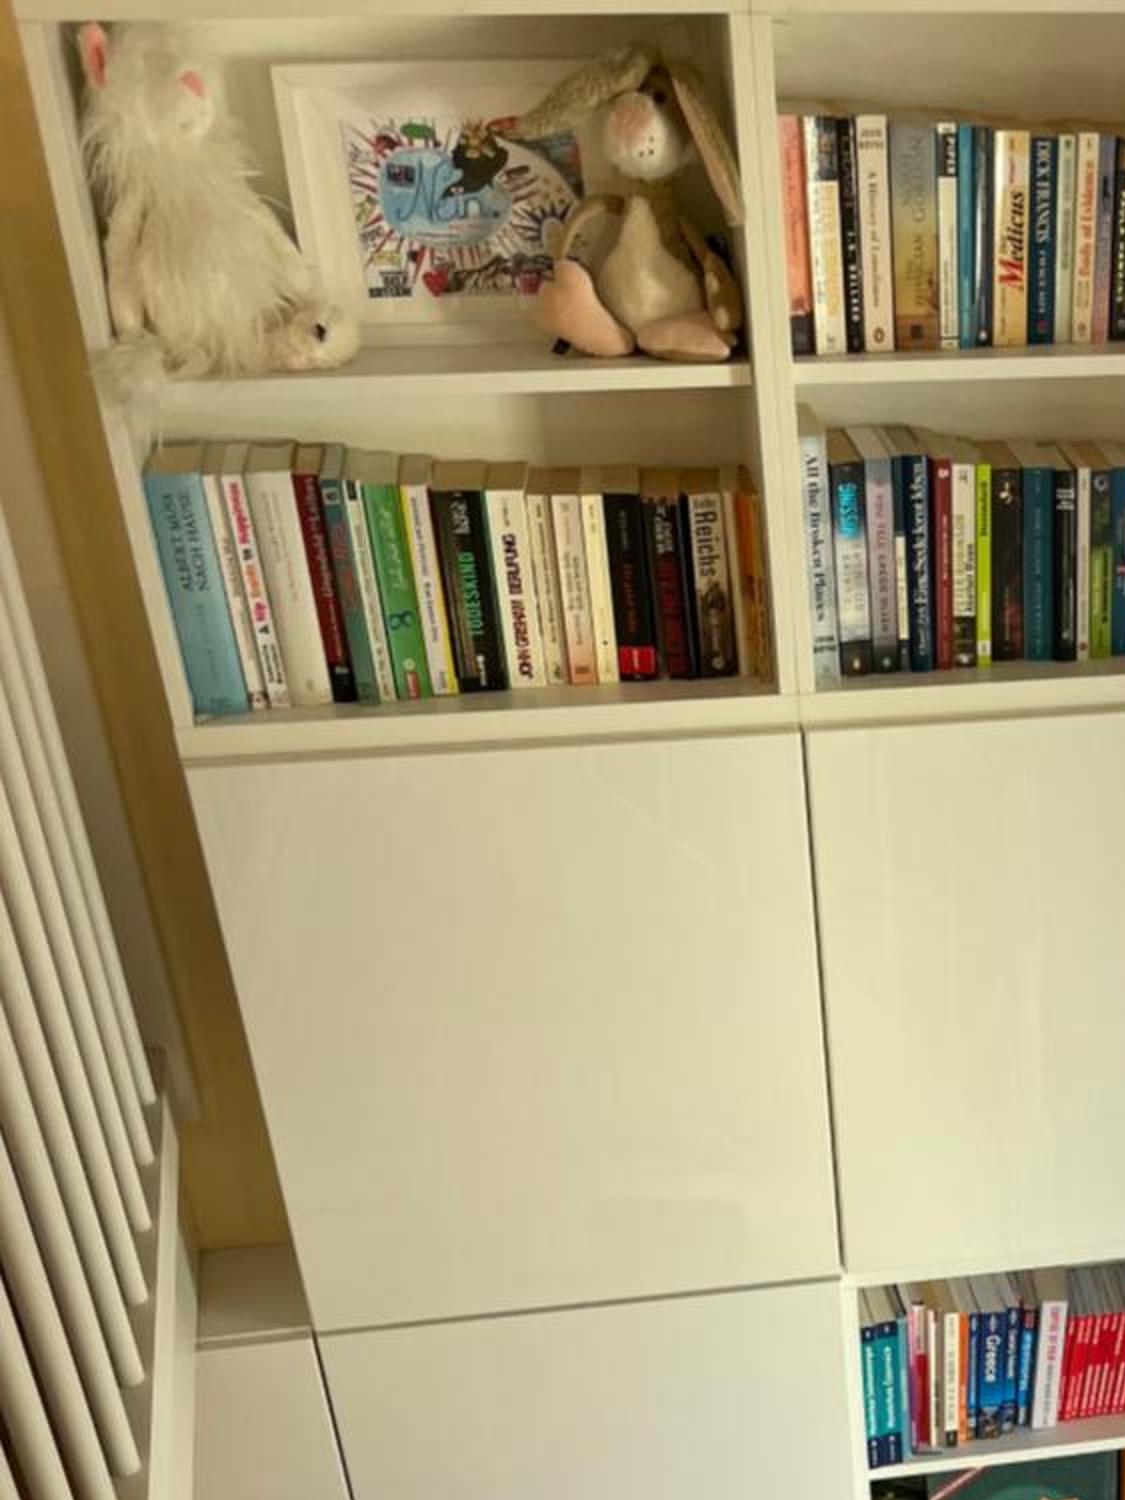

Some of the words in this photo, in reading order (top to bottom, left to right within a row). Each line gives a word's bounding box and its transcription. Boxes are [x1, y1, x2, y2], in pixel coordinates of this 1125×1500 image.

[1035, 141, 1051, 179] DICK
[1035, 180, 1051, 243] FRANCIS
[998, 191, 1025, 289] Medicus
[805, 453, 820, 478] All
[162, 493, 180, 531] MUSS
[179, 493, 199, 543] HAUSE
[229, 482, 250, 545] Happiness
[807, 481, 821, 509] the
[170, 537, 193, 592] ALBERT
[501, 533, 523, 595] BERUFUNG
[695, 511, 722, 578] Reichs
[808, 512, 826, 569] Broken
[190, 546, 210, 592] NACH
[457, 551, 484, 636] TODESKIND
[252, 601, 267, 622] Hip
[813, 572, 828, 623] Places
[510, 599, 530, 648] GRISHAM
[516, 646, 534, 679] JOHN
[985, 1334, 1001, 1382] Greece
